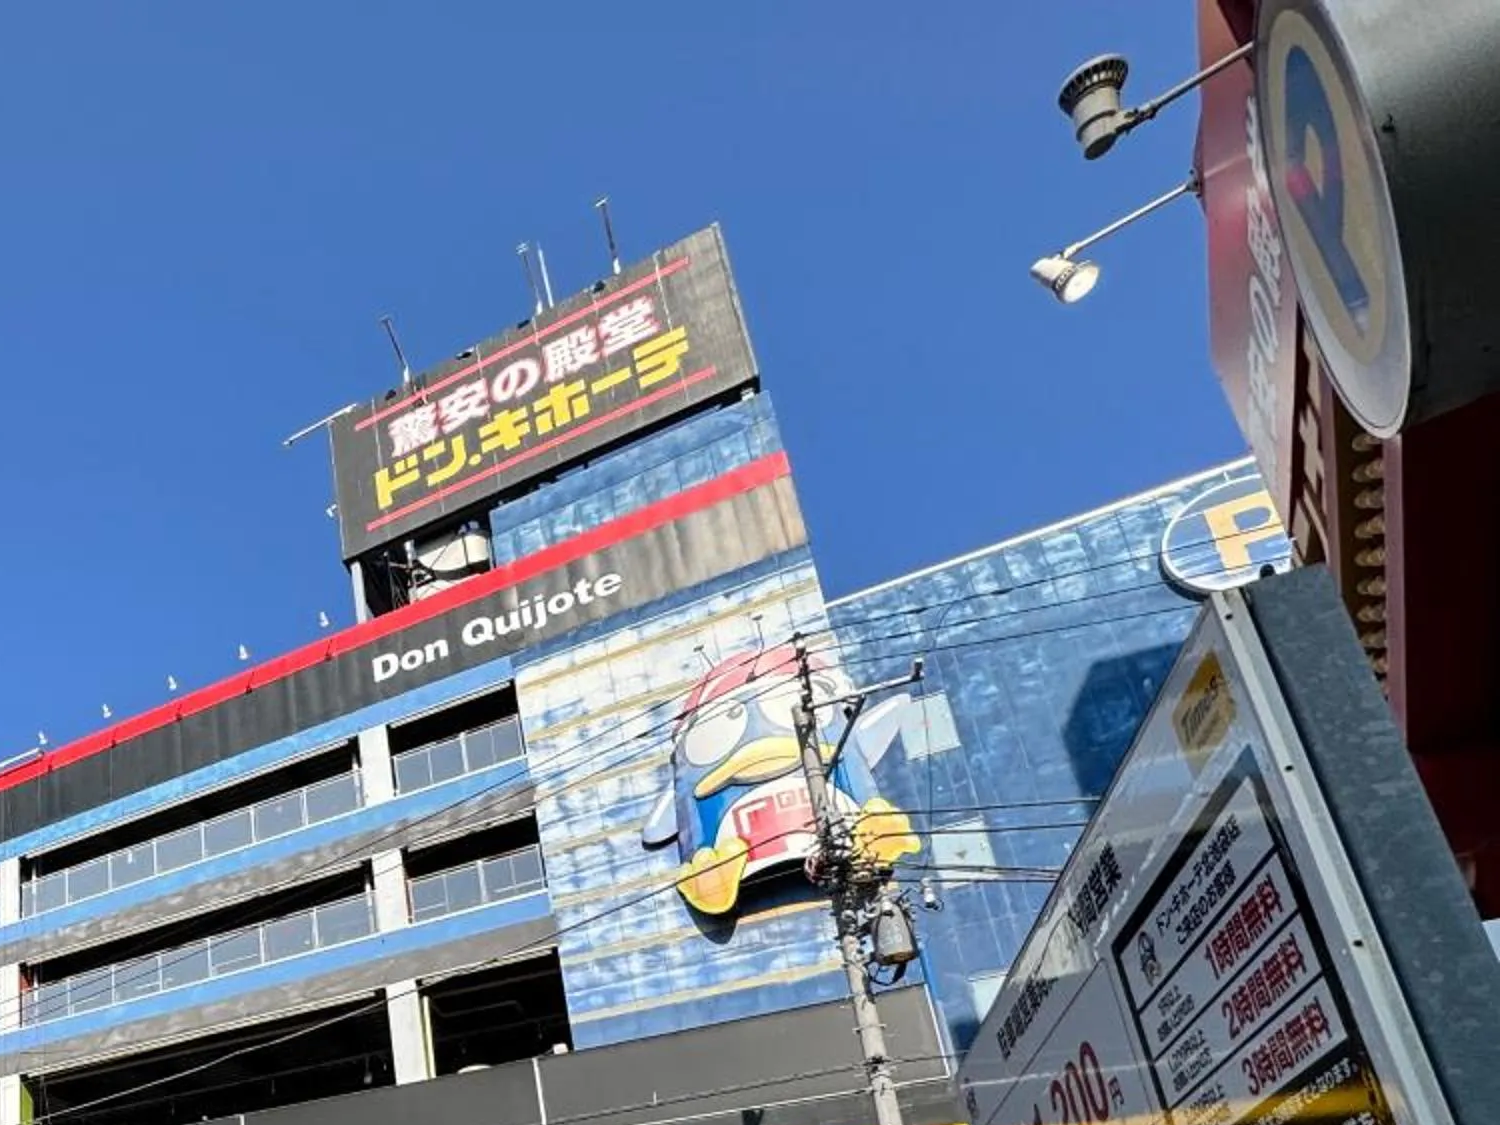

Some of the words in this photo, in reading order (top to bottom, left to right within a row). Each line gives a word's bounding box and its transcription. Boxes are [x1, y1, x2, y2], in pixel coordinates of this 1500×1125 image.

[388, 296, 660, 458] 驚安の殿堂
[372, 637, 449, 684] Don
[461, 572, 622, 648] Quijote
[1204, 873, 1284, 980] 1時間無料
[1221, 932, 1307, 1040] 2時間無料
[1241, 1002, 1333, 1096] 3時間無料
